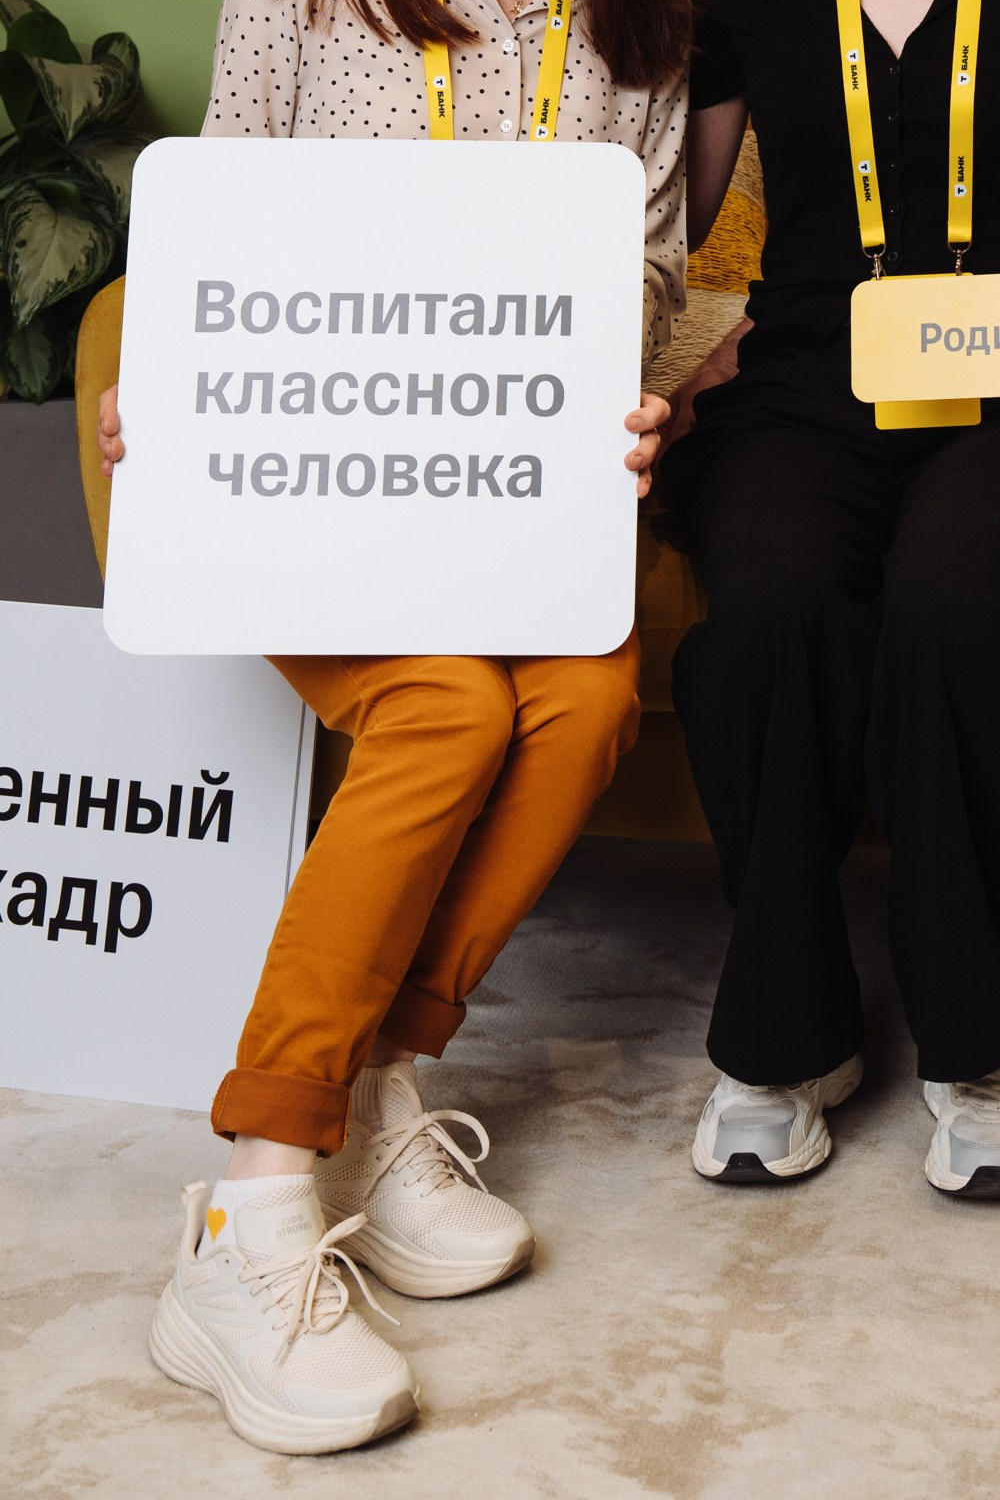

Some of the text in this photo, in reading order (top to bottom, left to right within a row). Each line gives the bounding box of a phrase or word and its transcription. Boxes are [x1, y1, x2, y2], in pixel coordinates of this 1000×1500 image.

[961, 45, 969, 71] БАНК
[850, 64, 859, 91] БАНК
[437, 91, 446, 118] БАНК
[540, 97, 550, 124] БАНК
[957, 155, 965, 183] БАНК
[862, 175, 872, 202] БАНК
[194, 280, 573, 336] Воспитали
[195, 371, 565, 417] классного
[208, 452, 543, 498] человека
[0, 869, 153, 954] адр
[275, 1220, 313, 1239] STROBBS
